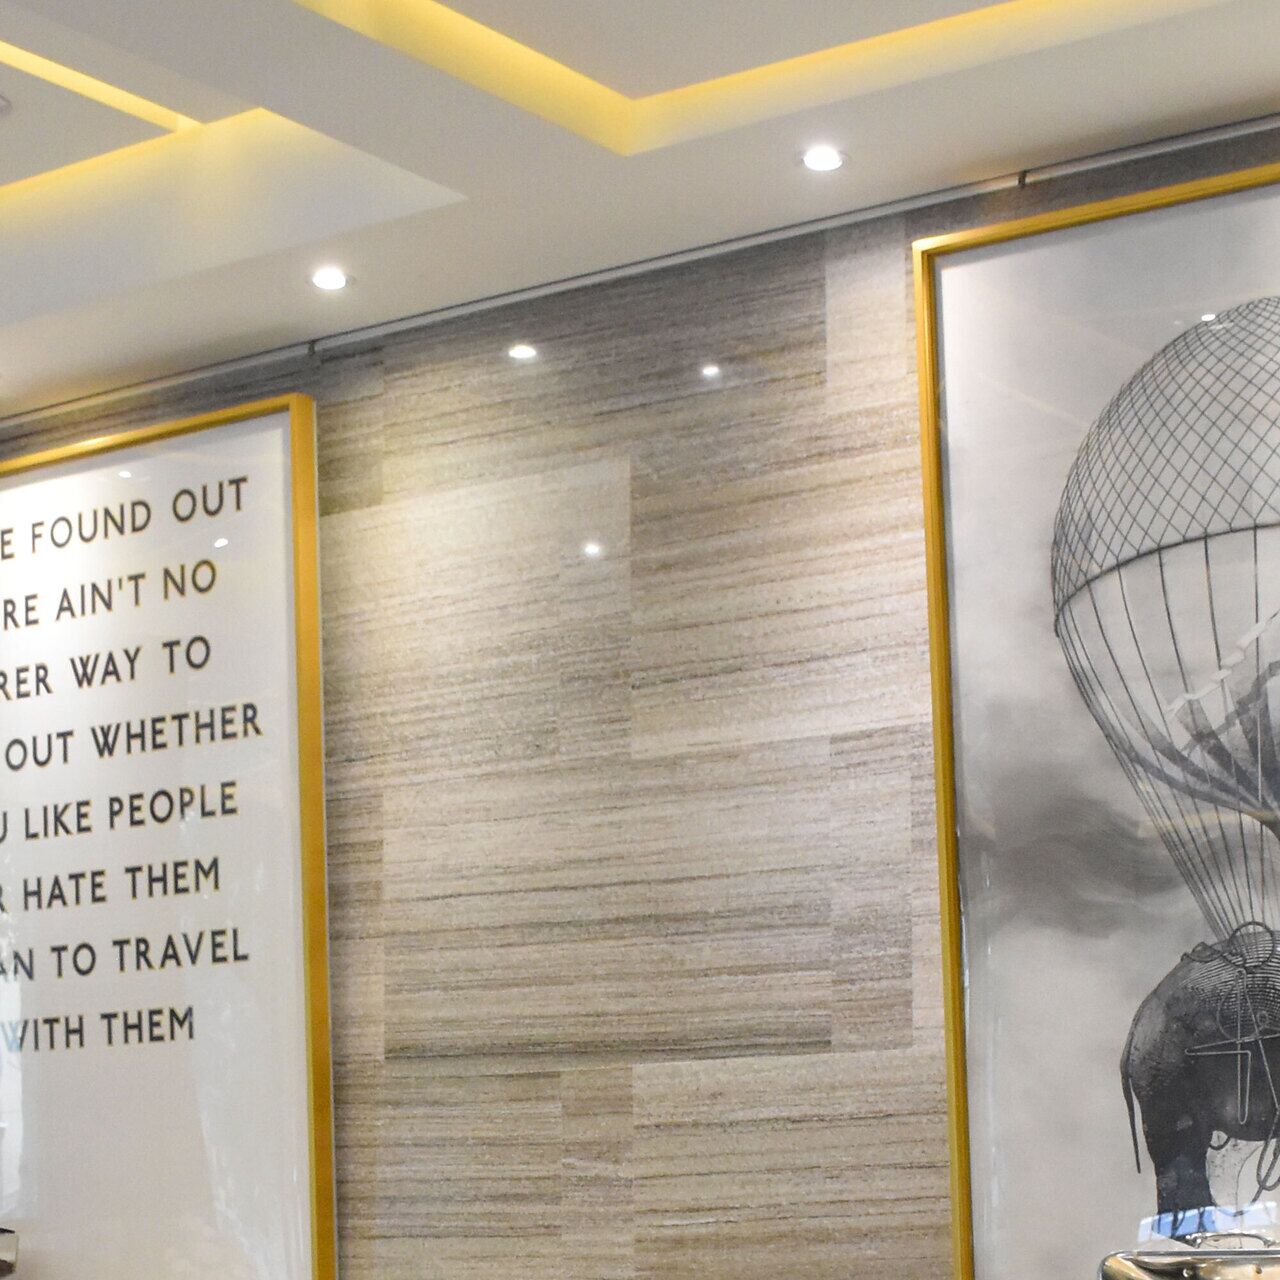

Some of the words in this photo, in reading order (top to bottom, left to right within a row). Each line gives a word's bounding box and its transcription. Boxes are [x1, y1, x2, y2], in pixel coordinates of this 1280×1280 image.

[31, 500, 152, 554] FOUND
[172, 476, 249, 522] OUT
[55, 572, 146, 621] AIN'T
[163, 559, 217, 600] NO
[70, 647, 142, 689] WAY
[162, 635, 211, 674] TO
[5, 730, 75, 771] OUT
[90, 702, 262, 759] WHETHER
[24, 800, 92, 840] LIKE
[109, 781, 238, 830] PEOPLE
[23, 869, 107, 912] HATE
[125, 857, 220, 900] THEM
[51, 942, 96, 979] TO
[112, 927, 249, 972] TRAVEL
[1, 1014, 85, 1053] WITH
[101, 1006, 195, 1046] THEM
